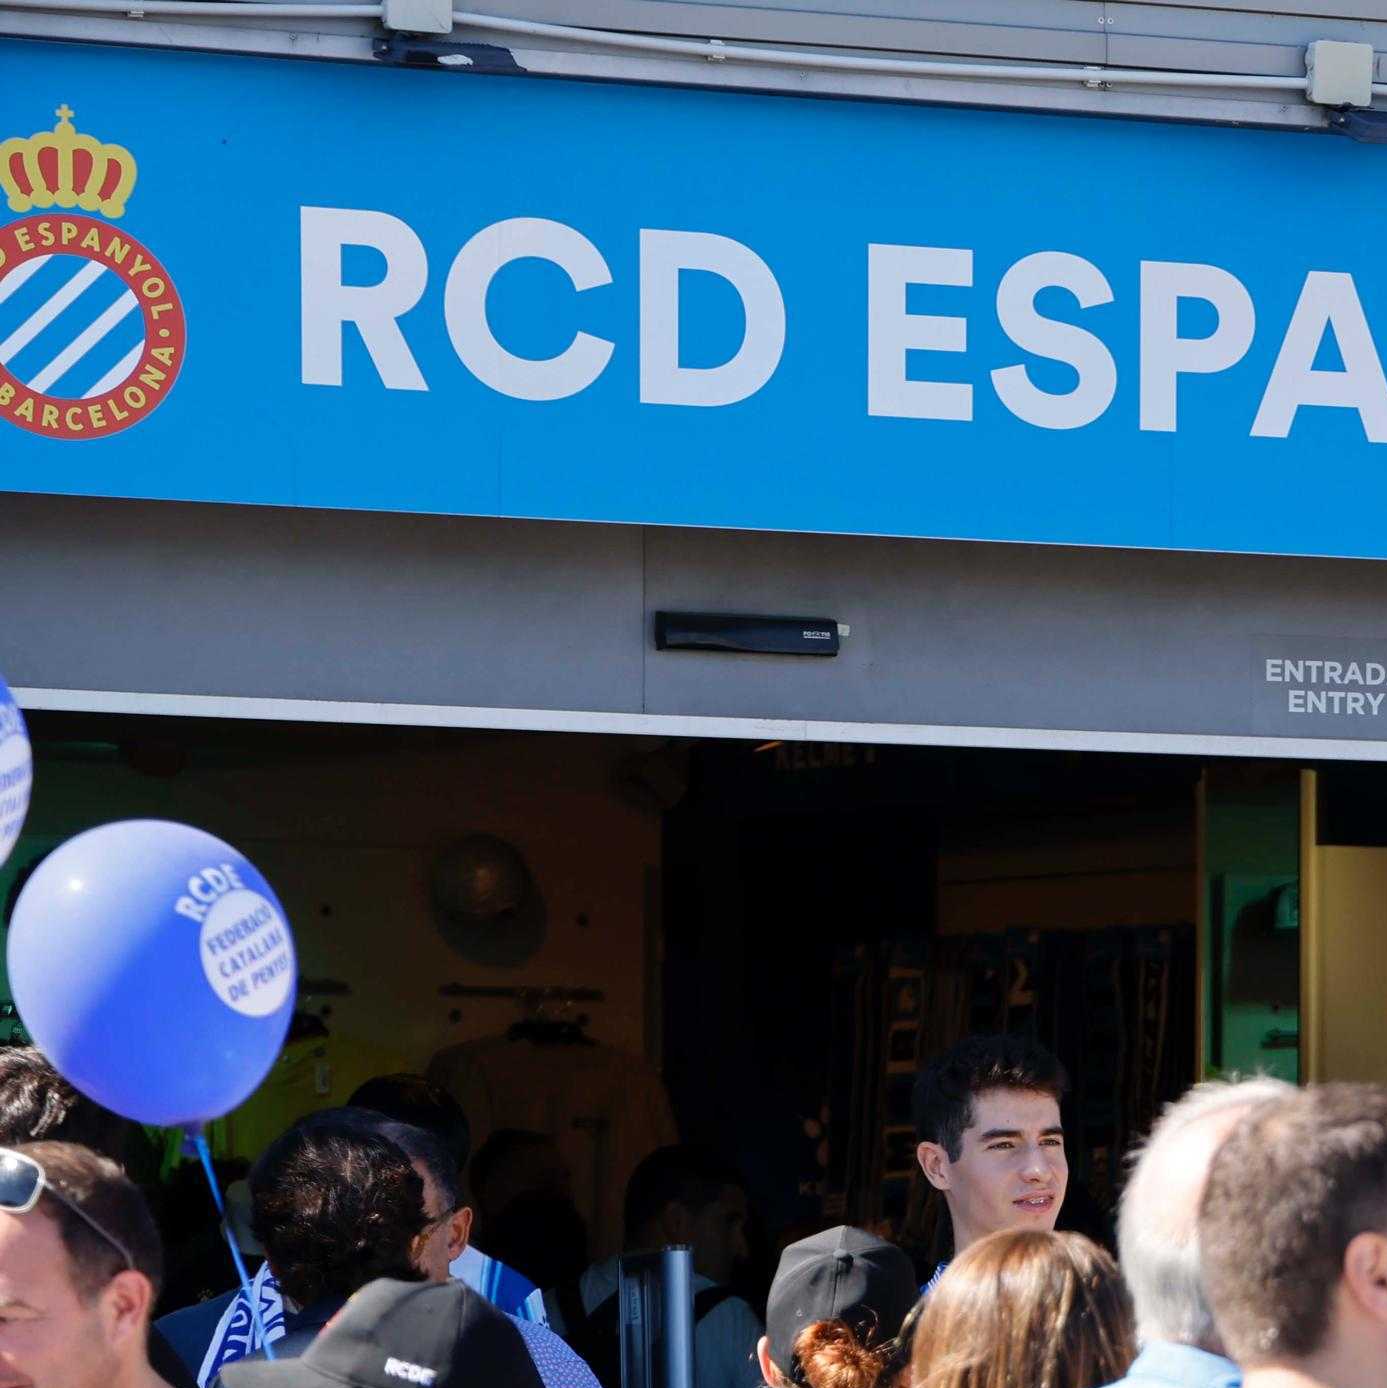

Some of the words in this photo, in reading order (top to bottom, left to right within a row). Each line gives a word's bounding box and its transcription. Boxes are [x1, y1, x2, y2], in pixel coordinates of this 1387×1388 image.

[14, 221, 174, 320] ESPANYOL
[300, 205, 786, 407] RCD
[0, 346, 175, 431] BARCELONA
[1288, 689, 1386, 715] ENTRY
[174, 863, 244, 924] RCDE
[227, 978, 249, 1002] DE
[384, 1356, 438, 1386] RCDE
